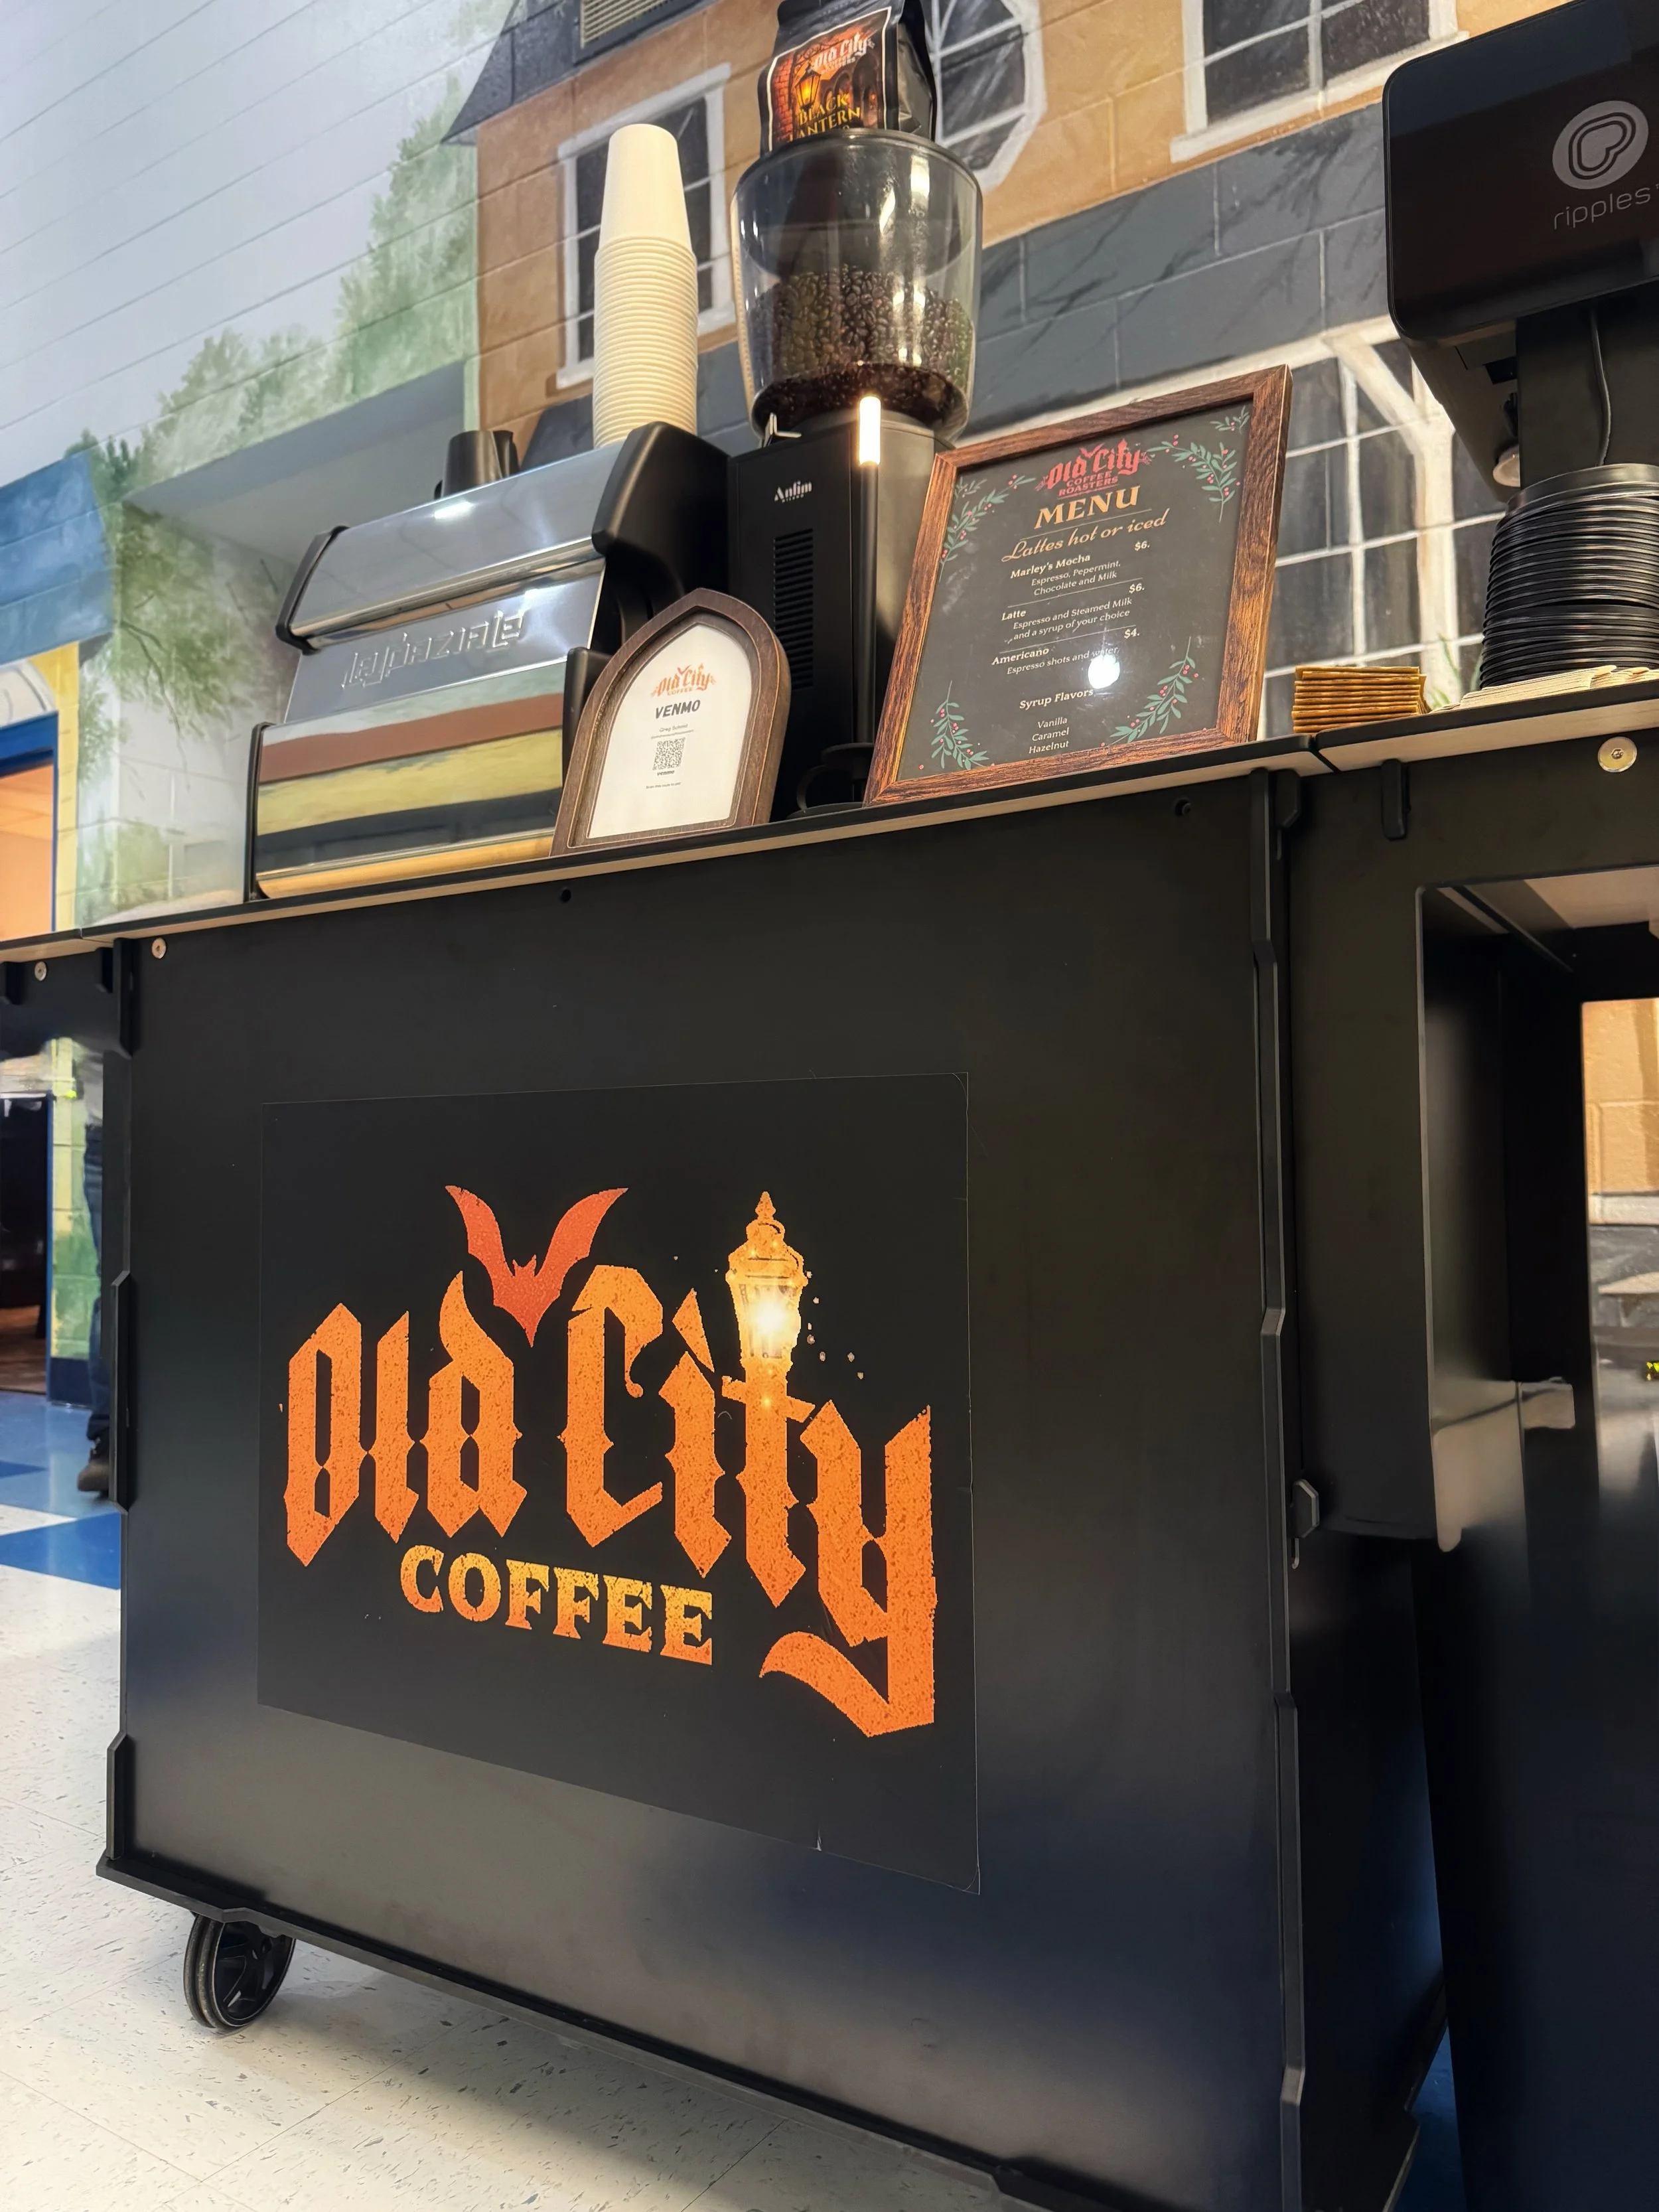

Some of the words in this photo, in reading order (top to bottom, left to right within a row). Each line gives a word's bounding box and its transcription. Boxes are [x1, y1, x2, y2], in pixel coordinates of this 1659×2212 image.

[799, 91, 849, 125] BLACK
[1046, 455, 1088, 490] Old
[1092, 438, 1141, 475] City
[1058, 476, 1119, 496] ROASTERS
[1066, 471, 1113, 487] COFFEE
[1034, 485, 1140, 530] MENU
[1001, 538, 1063, 561] Lattes
[1067, 526, 1098, 546] hot
[1100, 526, 1123, 538] or
[1127, 508, 1170, 533] iced
[1134, 540, 1150, 552] $6.
[1010, 562, 1053, 579] Marley's
[1055, 554, 1091, 569] Mocha
[1034, 581, 1076, 596] Chocolate
[1078, 576, 1096, 586] and
[1098, 571, 1117, 582] Milk
[1129, 583, 1145, 594] $6.
[1001, 610, 1027, 621] Latte
[1013, 617, 1050, 632] Espresso
[1052, 609, 1069, 620] and
[1071, 601, 1110, 617] Steamed
[1112, 597, 1132, 609] Milk
[1013, 630, 1030, 640] and
[1039, 625, 1064, 636] syrup
[1100, 609, 1130, 622] choice
[1123, 629, 1140, 639] $4.
[991, 646, 1050, 666] Americano
[1007, 661, 1045, 675] Espresso
[1046, 655, 1070, 666] shots
[1072, 650, 1090, 662] and
[655, 700, 701, 719] VENMO
[1019, 697, 1052, 710] Syrup
[1054, 688, 1094, 703] Flavors
[1037, 717, 1068, 729] Vanilla
[1032, 727, 1069, 742] Caramel
[1029, 740, 1070, 754] Hazelnut
[283, 1272, 528, 1567] Old
[556, 1191, 937, 1736] City
[400, 1544, 712, 1664] COFFEE
